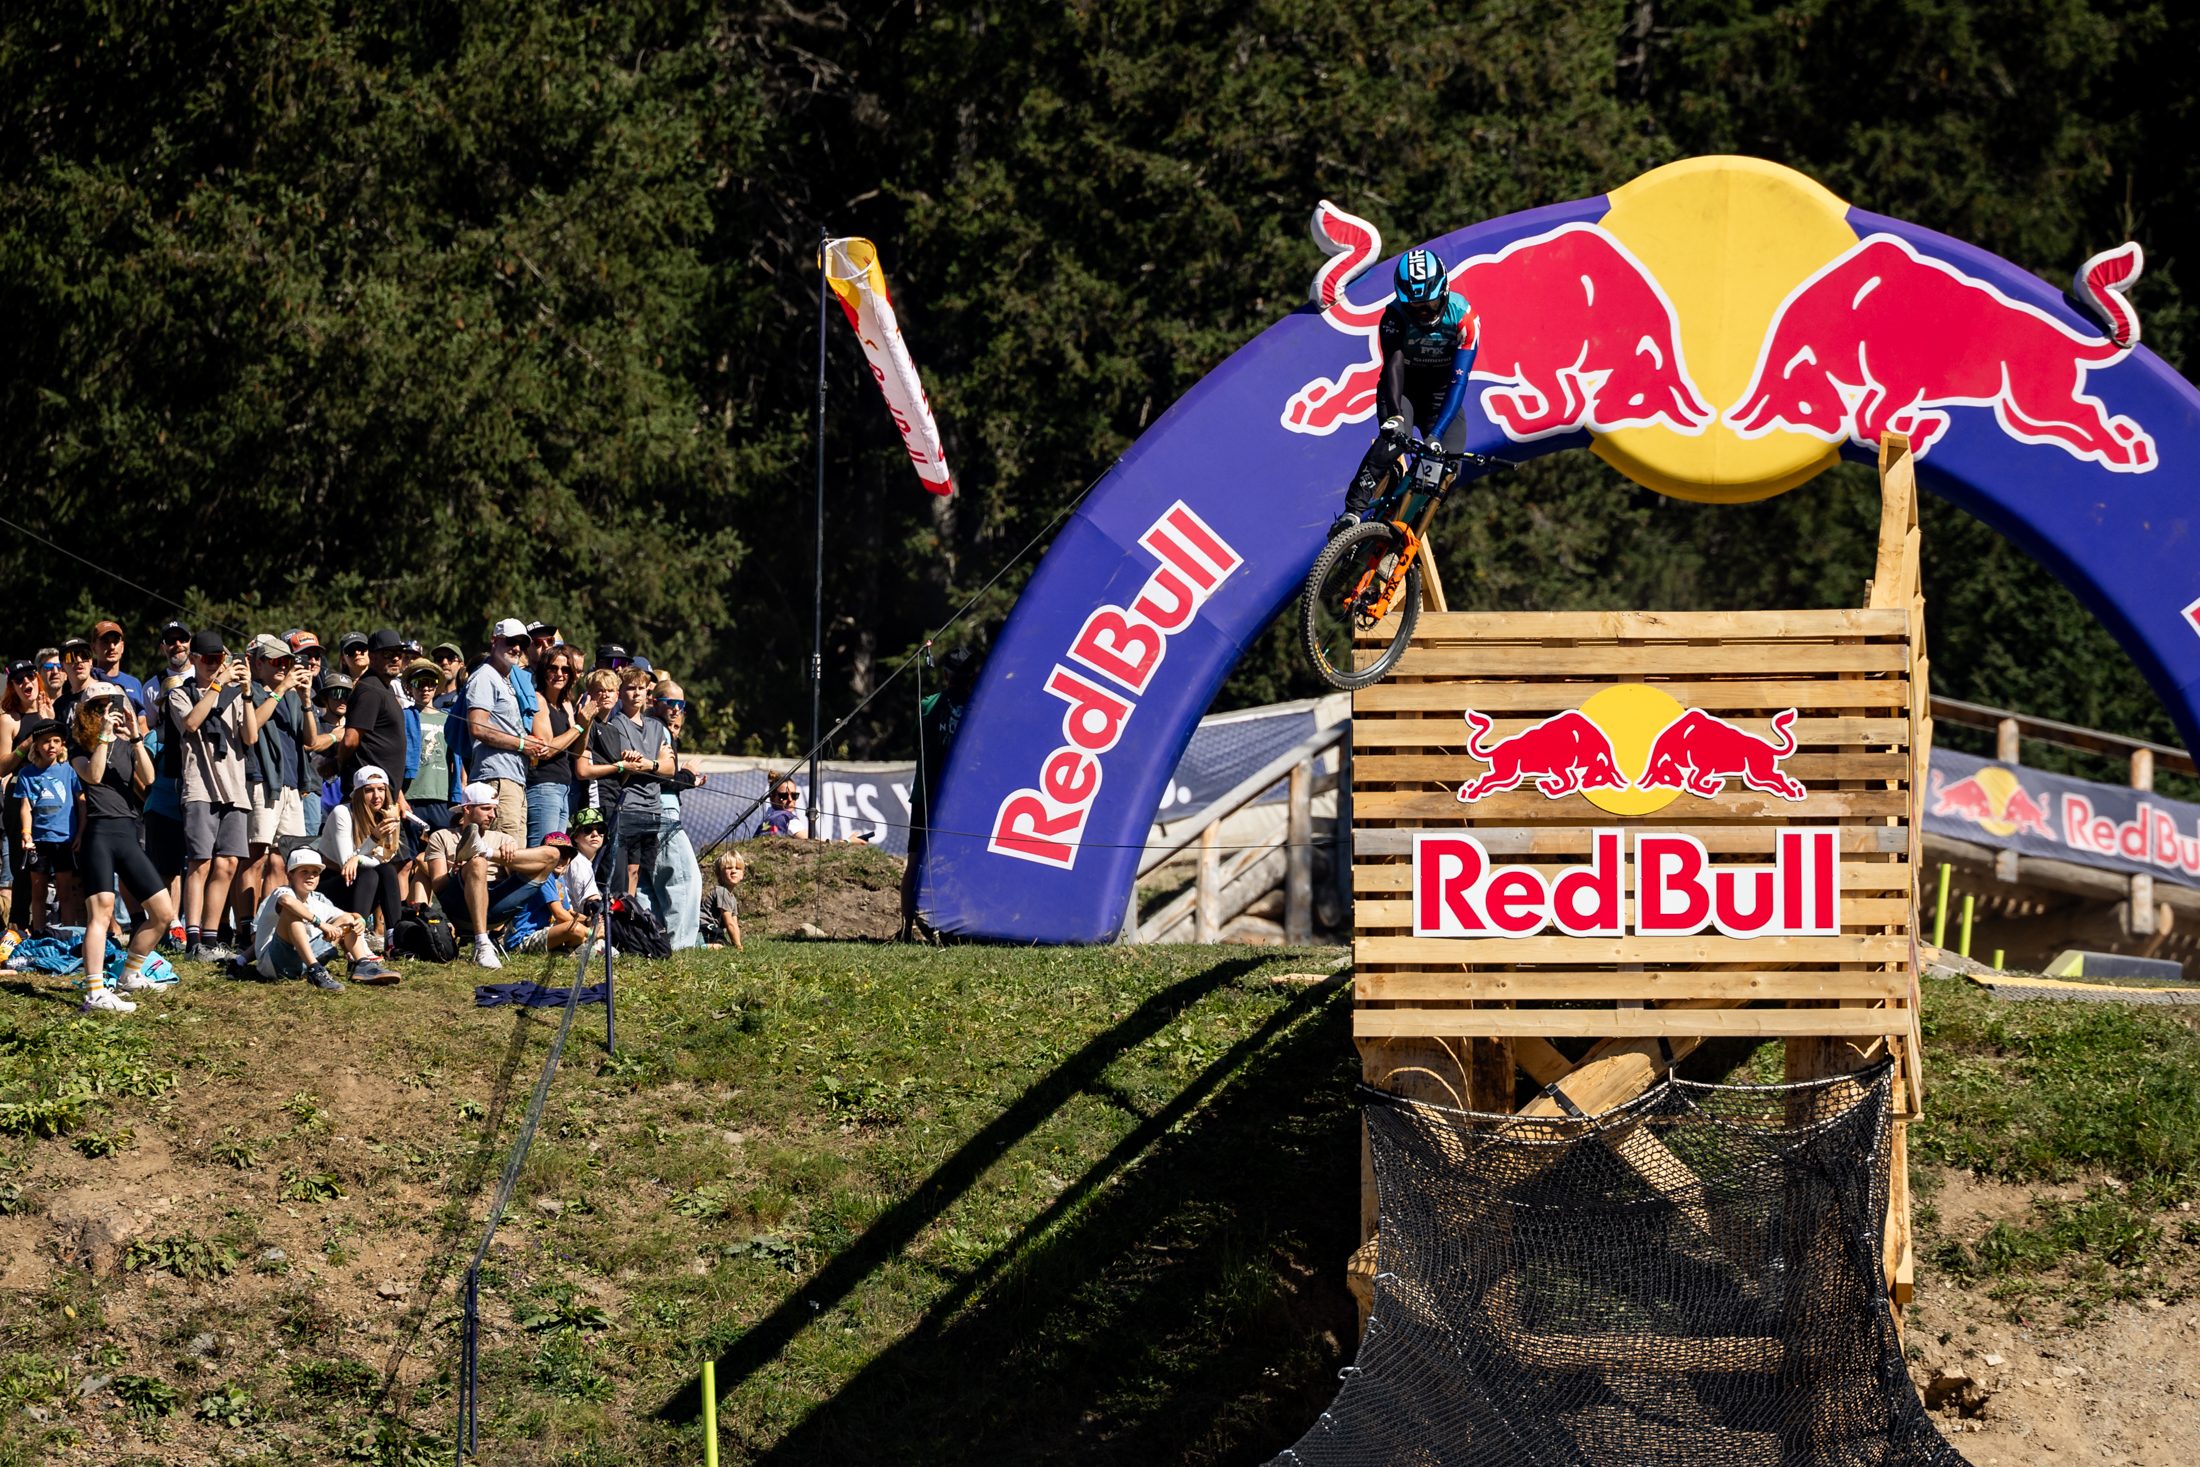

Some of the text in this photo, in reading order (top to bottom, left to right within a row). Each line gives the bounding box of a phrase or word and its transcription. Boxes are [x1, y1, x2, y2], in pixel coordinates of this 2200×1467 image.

[1420, 346, 1445, 356] FOX
[1424, 464, 1433, 478] 2
[1381, 577, 1400, 603] FOX
[988, 500, 1242, 868] Red Bull
[2063, 792, 2151, 861] Red
[1415, 829, 1838, 937] Red Bull
